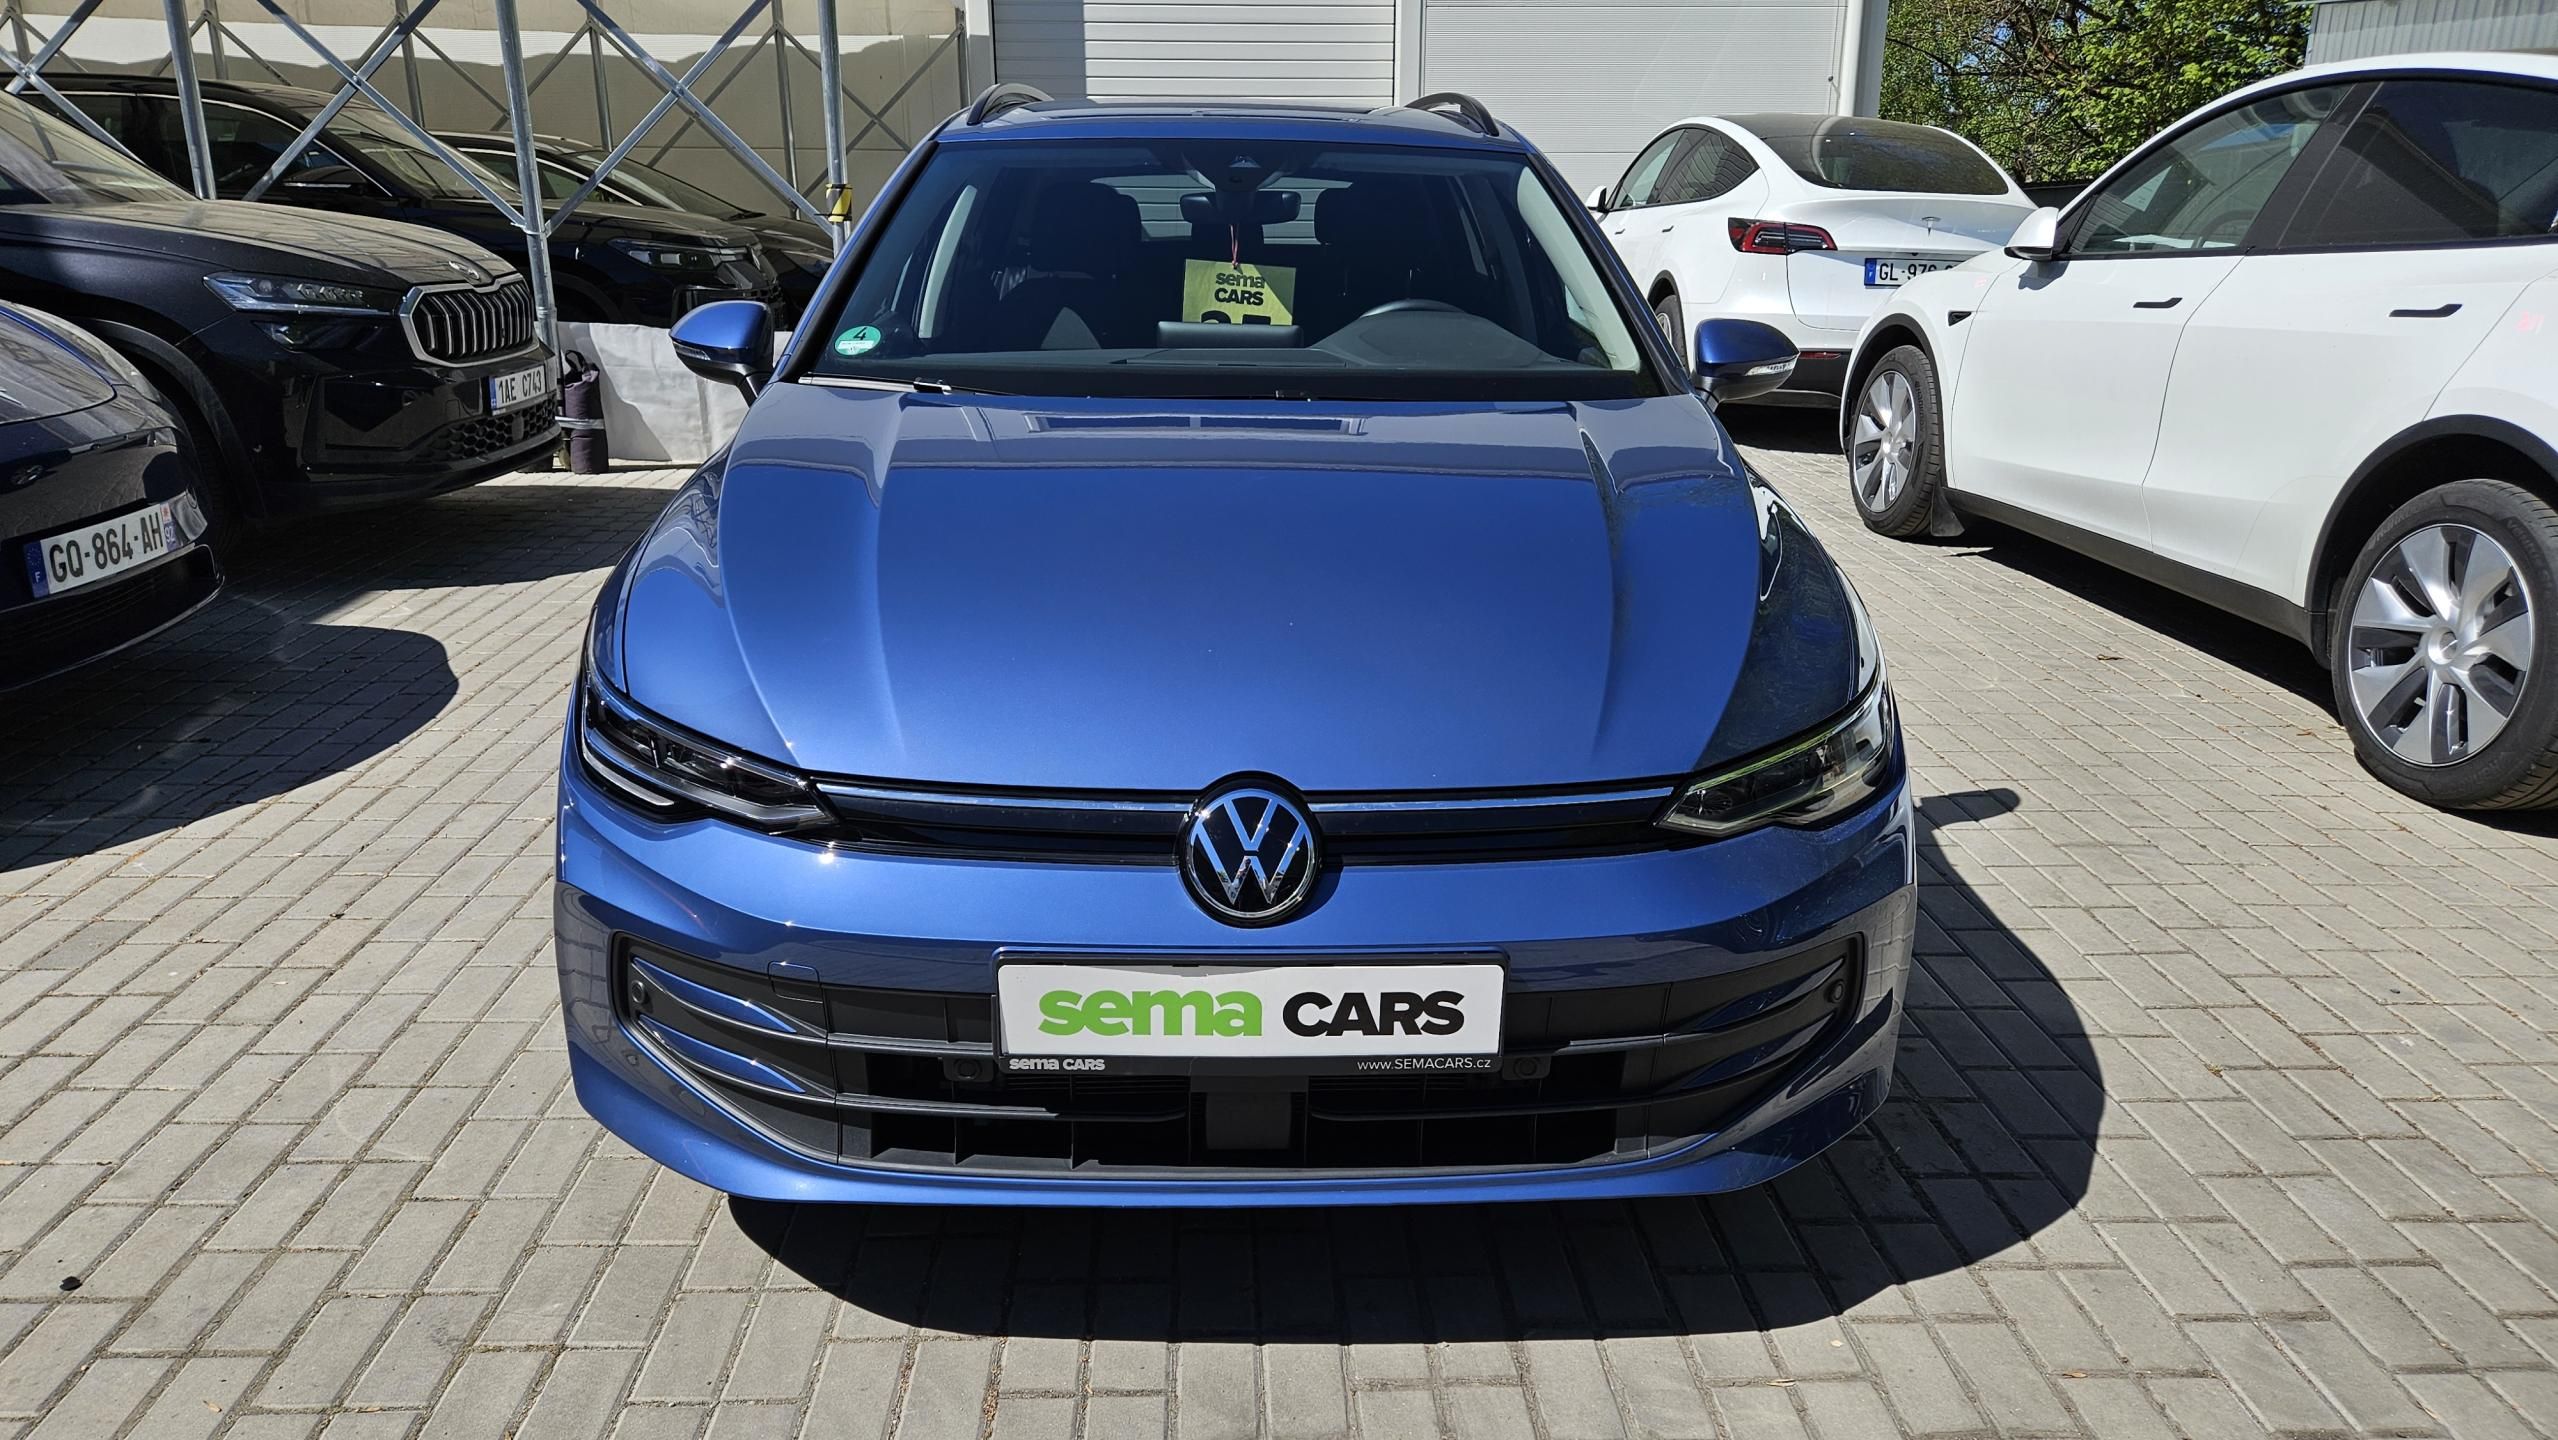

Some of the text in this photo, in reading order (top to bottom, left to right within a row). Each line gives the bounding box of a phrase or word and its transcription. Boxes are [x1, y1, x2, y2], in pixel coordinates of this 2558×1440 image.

[1216, 273, 1265, 288] sema
[1214, 288, 1264, 306] CARS
[853, 327, 867, 340] 4
[499, 370, 542, 403] 1AE C743
[49, 512, 163, 582] GQ-864-AH
[1038, 990, 1465, 1037] sema CARS
[1009, 1058, 1106, 1071] sema CARS
[1357, 1057, 1492, 1070] www.SEMACARS.cz
